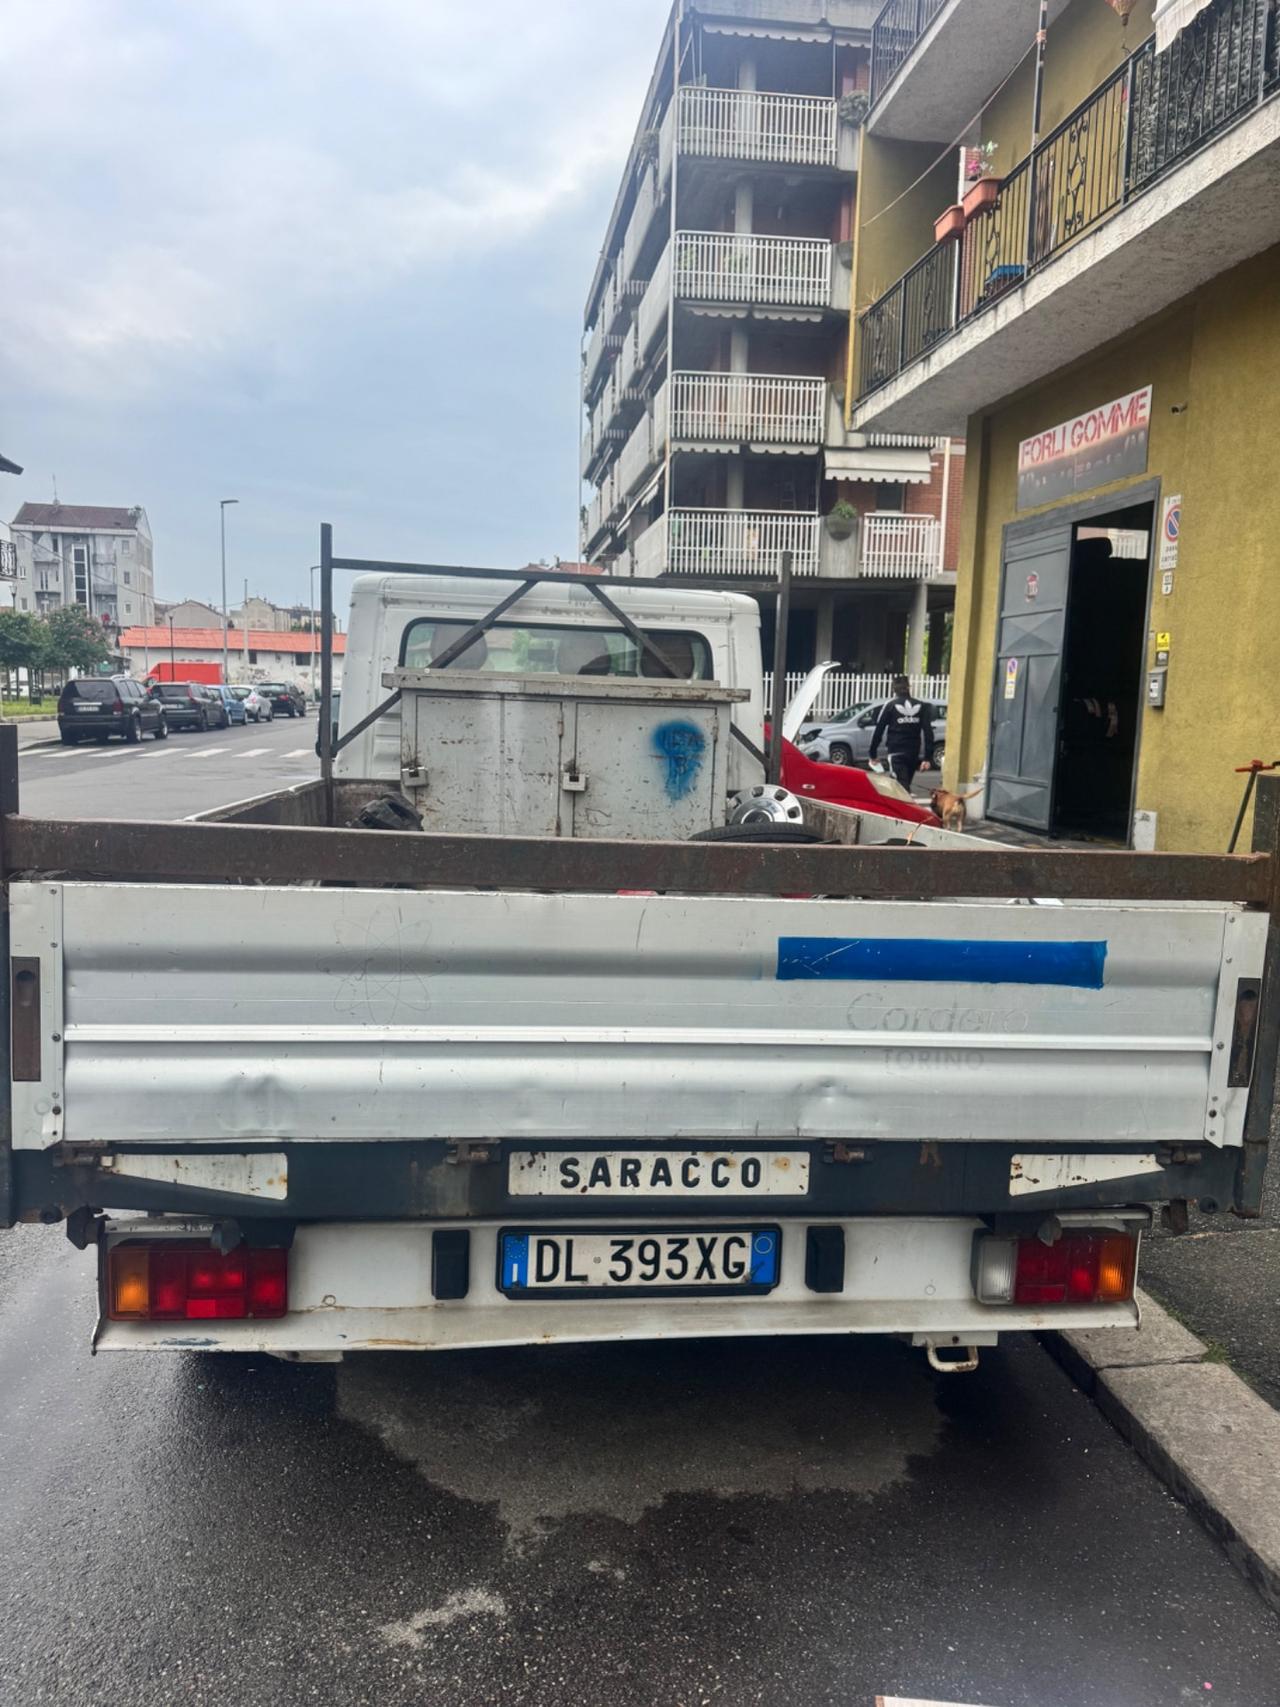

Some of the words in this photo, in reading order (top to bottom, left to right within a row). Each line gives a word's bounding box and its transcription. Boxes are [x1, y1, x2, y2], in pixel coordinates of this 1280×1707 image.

[1020, 425, 1067, 467] FORLI
[1071, 390, 1149, 449] GOMME
[882, 1049, 985, 1070] TORINO
[559, 1156, 762, 1188] SARACCO
[535, 1238, 589, 1283] DL
[608, 1236, 747, 1282] 393XG
